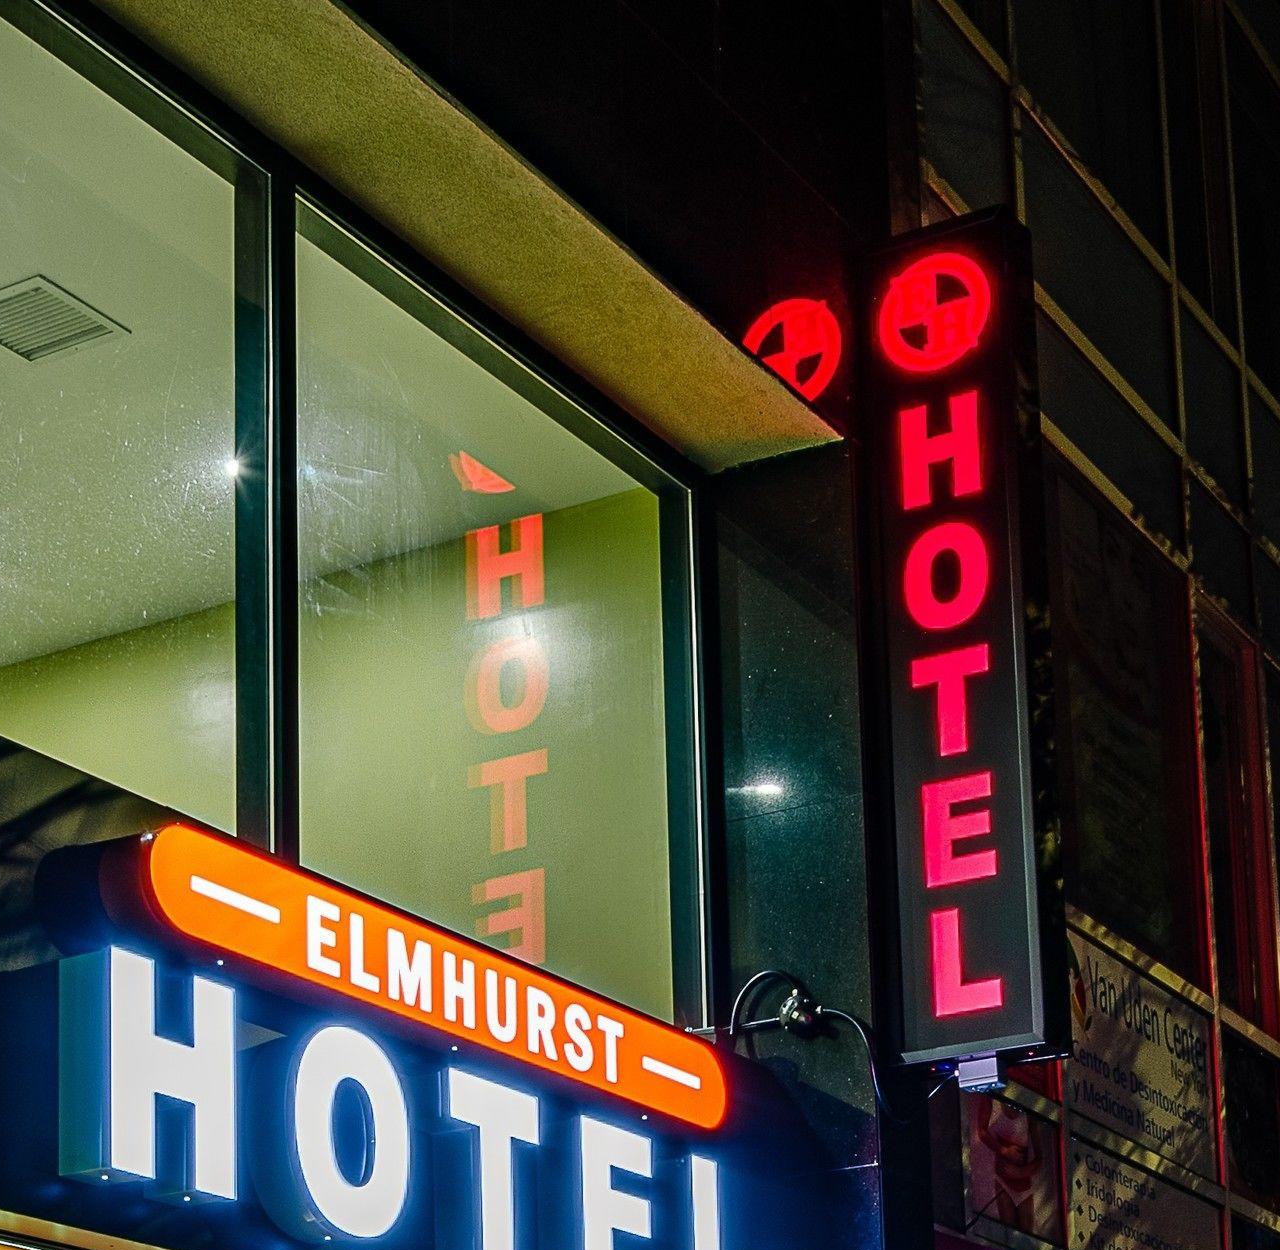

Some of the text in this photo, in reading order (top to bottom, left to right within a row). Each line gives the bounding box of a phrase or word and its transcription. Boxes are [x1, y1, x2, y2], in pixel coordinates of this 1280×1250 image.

[898, 390, 1002, 1018] HOTEL
[305, 894, 624, 1083] ELMHURST
[1086, 955, 1117, 1018] Van
[1121, 978, 1161, 1046] Uden
